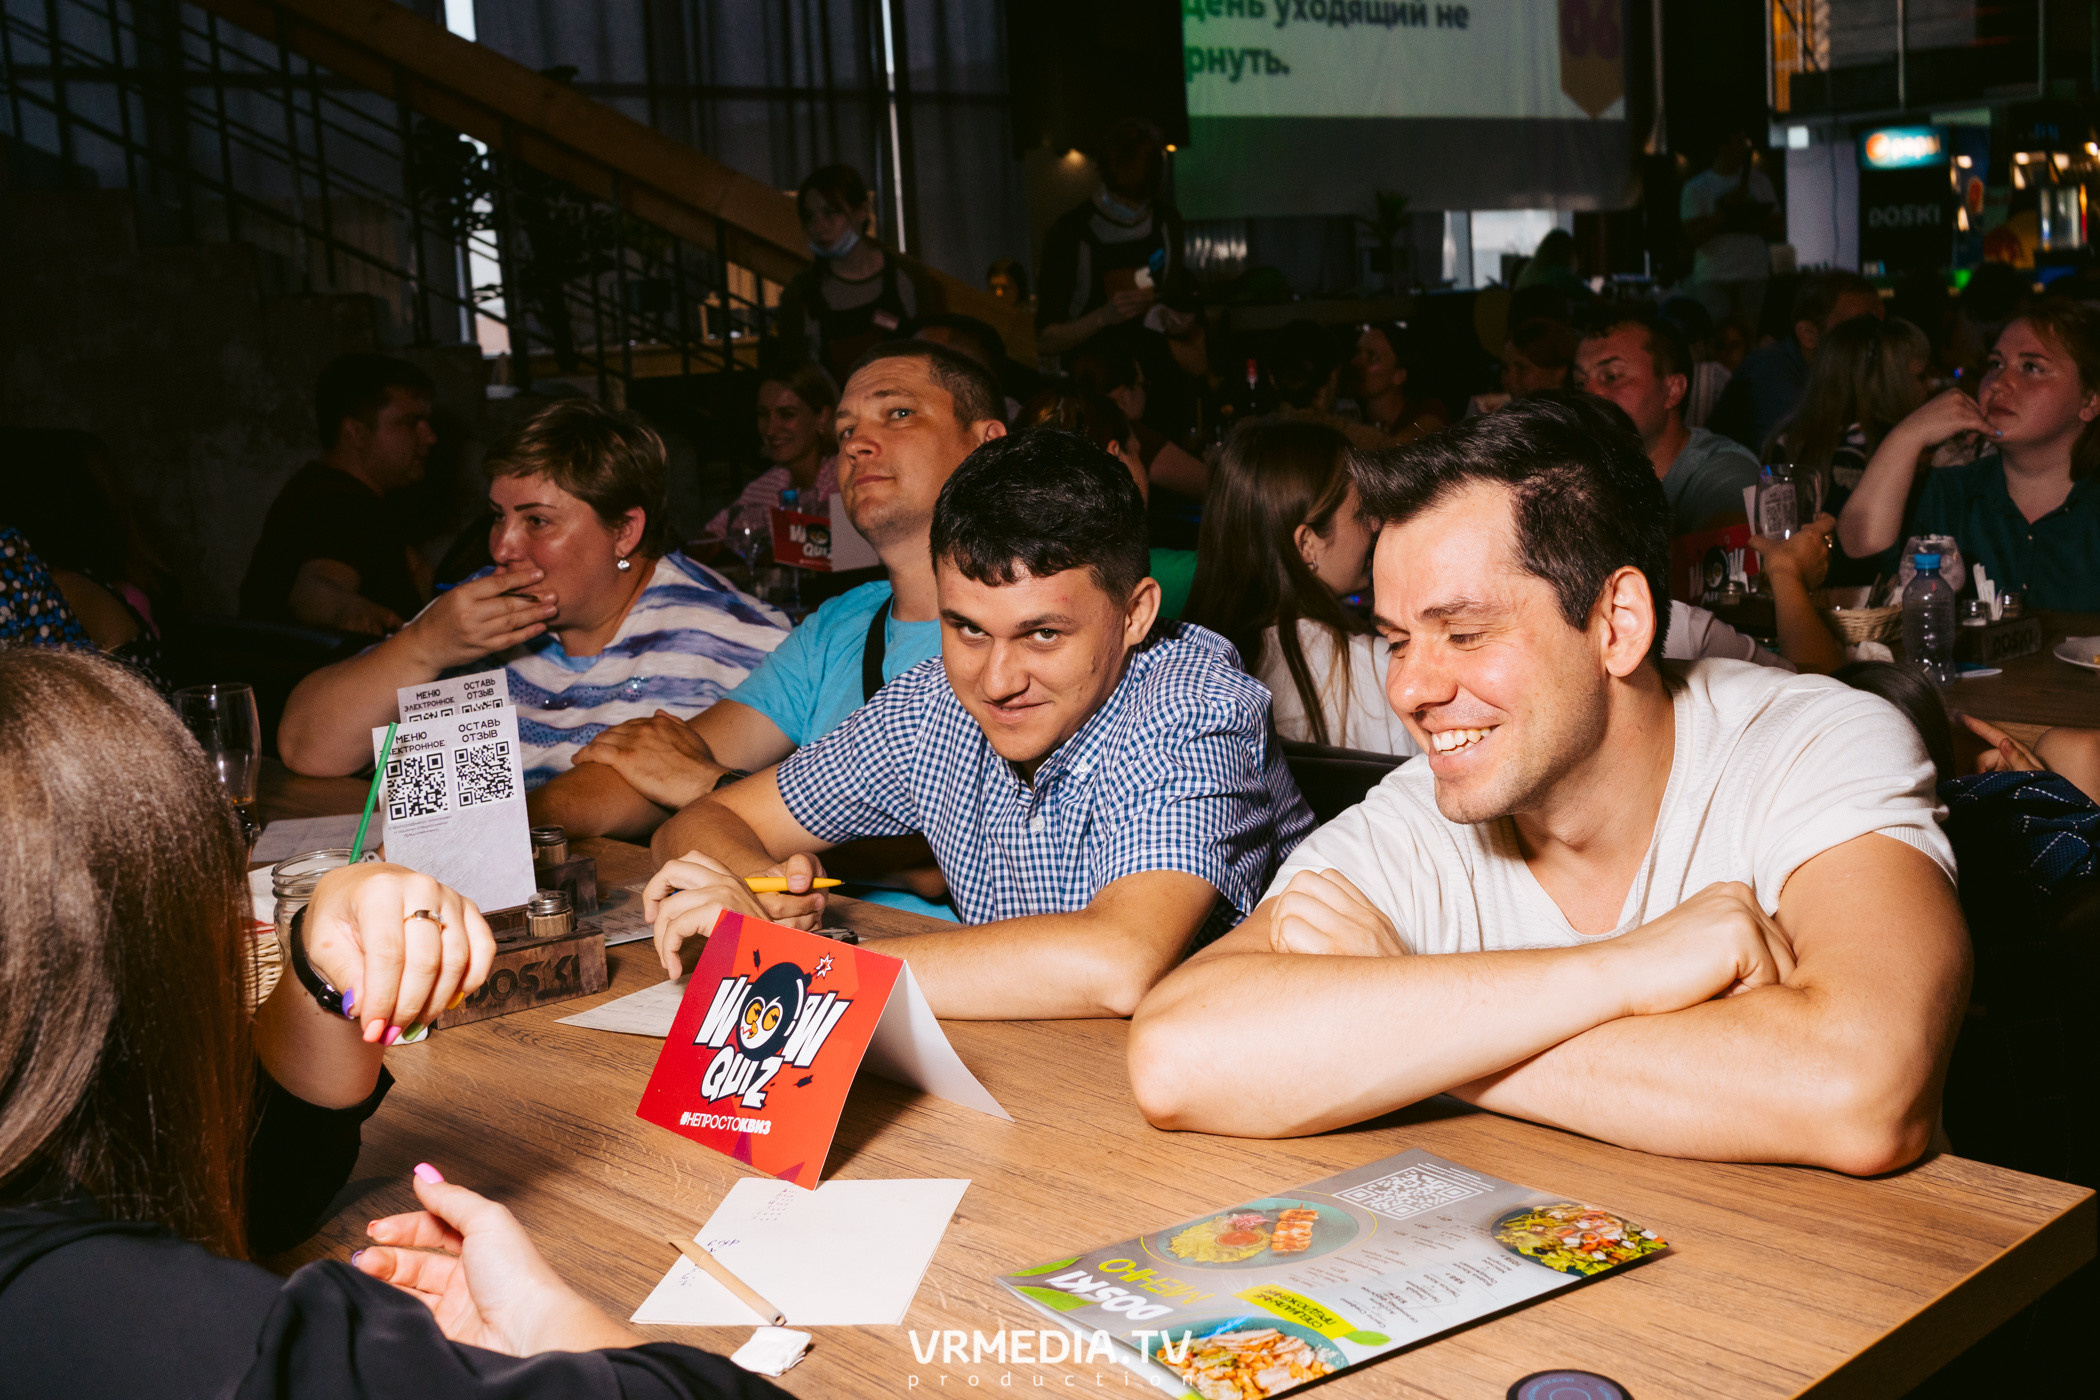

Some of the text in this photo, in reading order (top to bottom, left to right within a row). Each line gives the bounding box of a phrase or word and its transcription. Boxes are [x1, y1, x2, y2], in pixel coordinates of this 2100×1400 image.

[1436, 4, 1470, 29] не
[1868, 203, 1941, 230] DOSKI
[463, 678, 496, 691] ОСТАВЬ
[416, 688, 441, 701] МЕНЮ
[466, 688, 495, 700] ОТЗЫВ
[404, 696, 455, 713] ЭЛЕКТРОННОЕ
[458, 718, 501, 733] ОСТАВЬ
[395, 731, 428, 744] МЕНЮ
[461, 729, 498, 743] ОТЗЫВ
[380, 739, 446, 756] ЕКТРОННОЕ
[700, 1043, 784, 1111] QUIZ
[679, 1111, 772, 1135] #НЕПРОСТОКВИЗ
[1099, 1258, 1216, 1304] МЕНЮ
[1045, 1270, 1174, 1321] DOSKI
